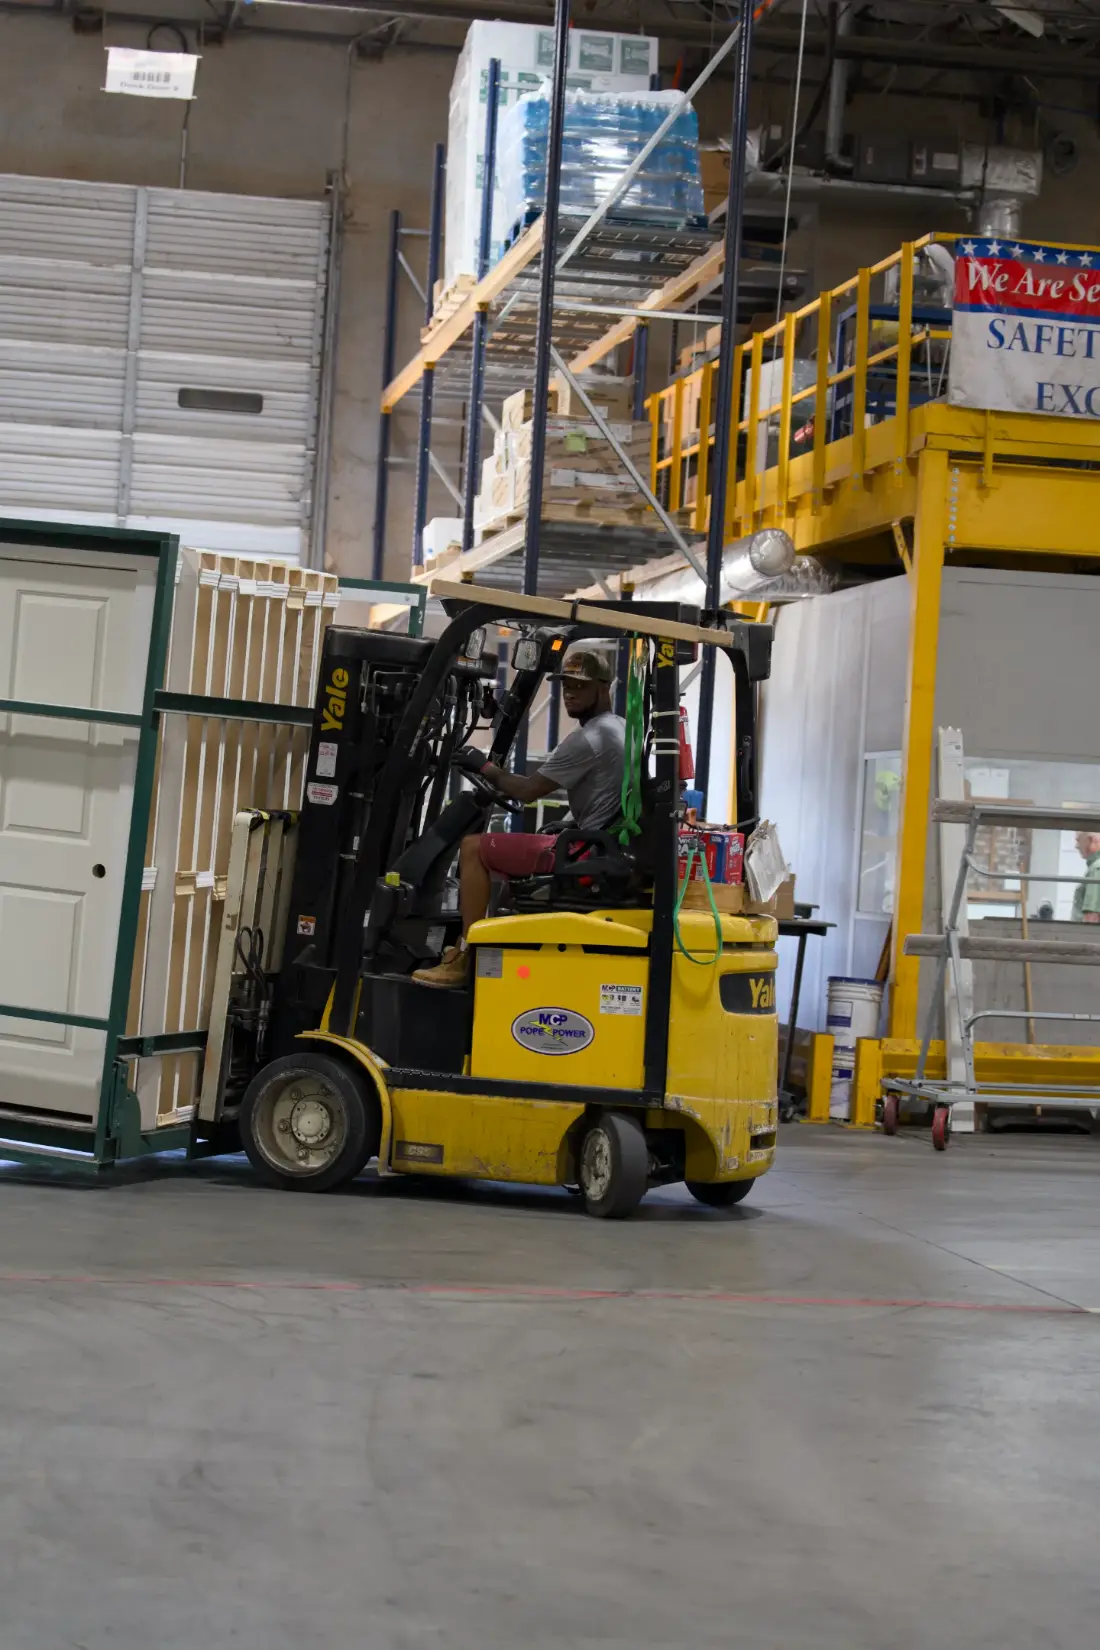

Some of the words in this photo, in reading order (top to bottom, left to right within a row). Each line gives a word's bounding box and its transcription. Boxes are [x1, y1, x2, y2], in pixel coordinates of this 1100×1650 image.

[966, 261, 1010, 292] We
[1012, 267, 1065, 299] Are
[1069, 272, 1100, 303] Se
[986, 318, 1100, 359] SAFET
[657, 637, 675, 668] Yal
[320, 667, 349, 731] Yale
[520, 1026, 545, 1037] POPE
[552, 1029, 587, 1038] POWER
[538, 1013, 568, 1026] MCP
